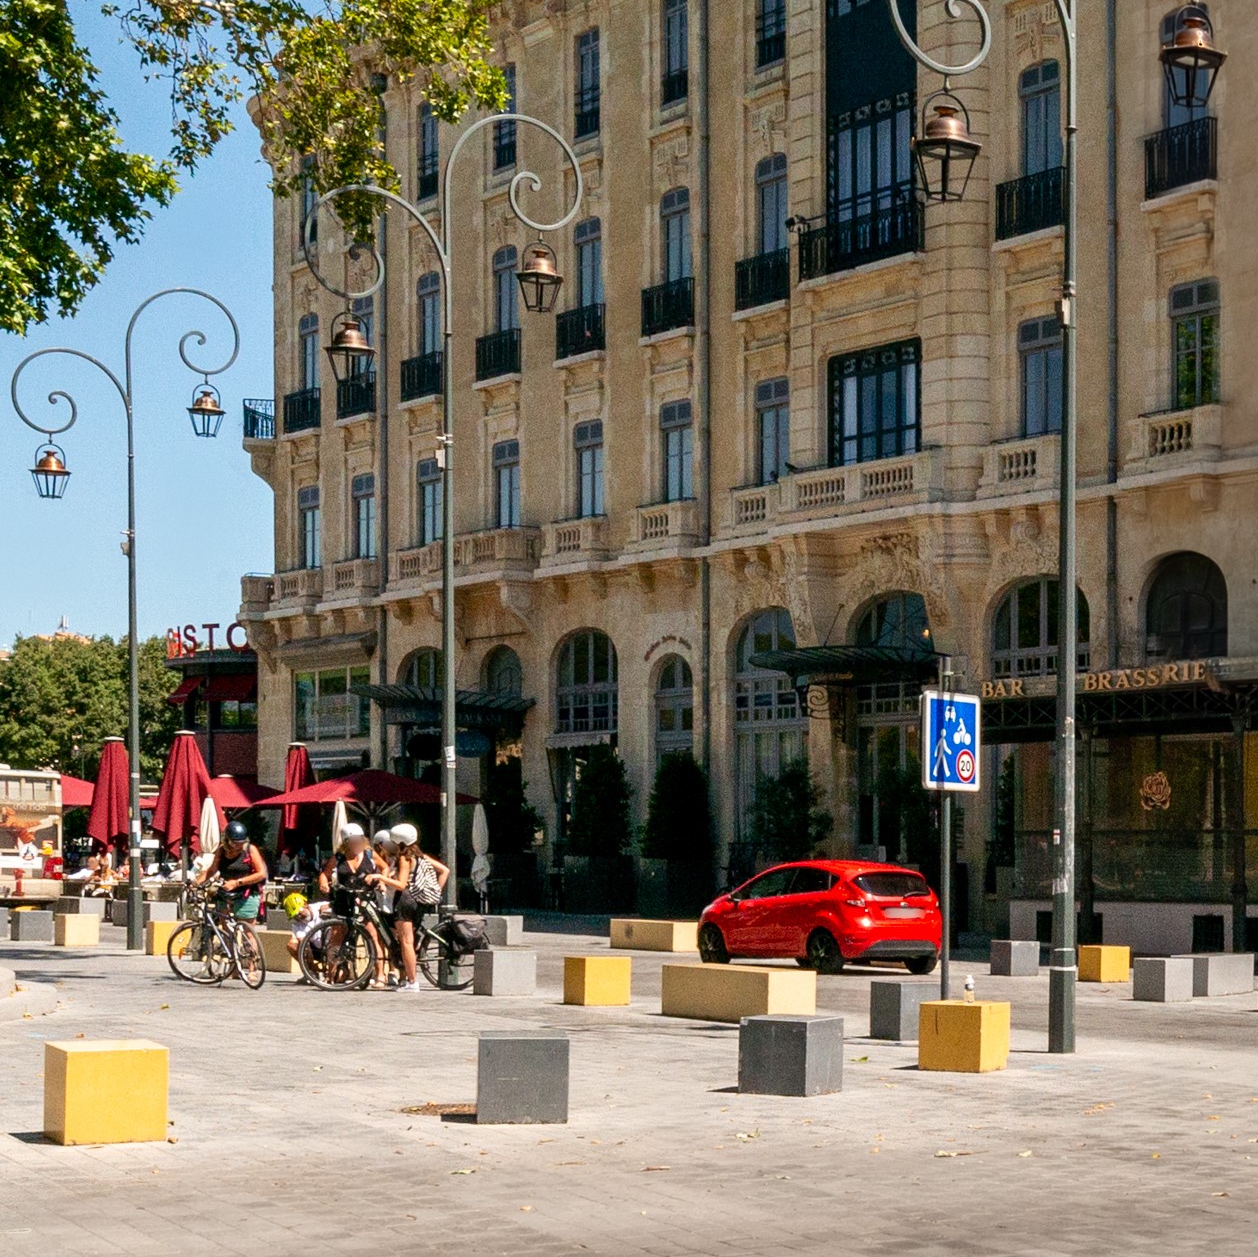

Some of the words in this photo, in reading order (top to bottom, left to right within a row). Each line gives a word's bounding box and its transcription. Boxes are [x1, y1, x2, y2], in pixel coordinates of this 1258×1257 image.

[981, 679, 1024, 698] BAR
[1084, 661, 1206, 691] BRASSRIE
[960, 760, 971, 772] 20
